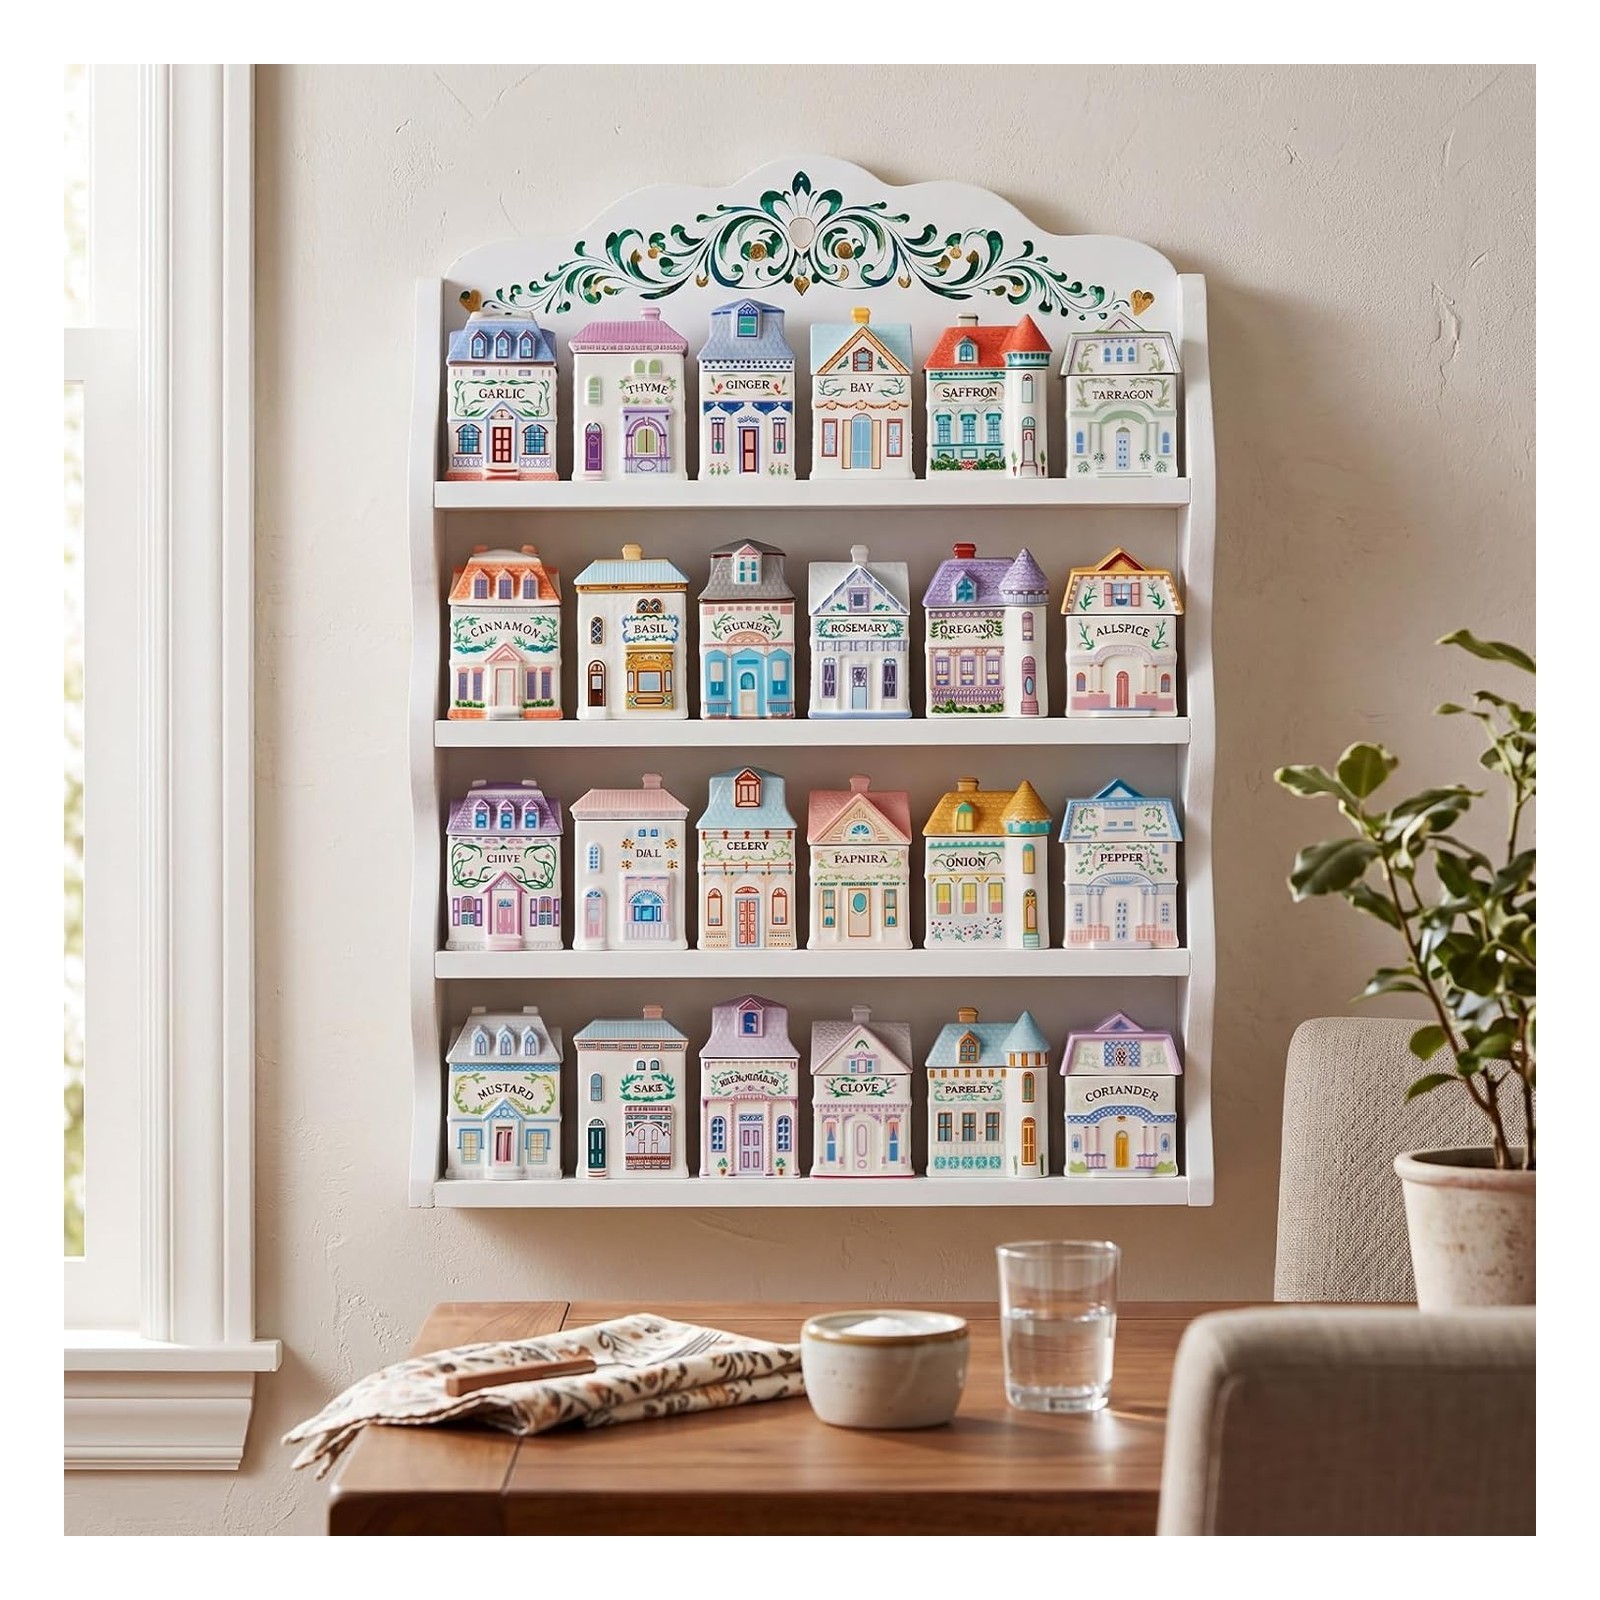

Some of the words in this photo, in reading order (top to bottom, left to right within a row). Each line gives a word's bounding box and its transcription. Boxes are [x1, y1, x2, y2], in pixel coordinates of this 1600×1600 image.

[626, 383, 670, 395] THYME
[726, 379, 770, 390] GINGER
[850, 383, 874, 392] BAY
[478, 389, 525, 399] GARLIC
[942, 386, 998, 397] SAFFRON
[1092, 389, 1154, 399] TARRAGON
[470, 620, 541, 638] CINNAMON
[634, 624, 668, 634] BASIL
[831, 623, 889, 633] ROSEMARY
[939, 623, 994, 634] OREGANO
[1095, 623, 1151, 638] ALLSPICE
[726, 841, 769, 851] CELERY
[834, 854, 888, 864] PAPNIRA
[945, 857, 986, 867] ONION
[1100, 853, 1144, 863] PEPPER
[477, 1083, 535, 1101] MUSTARD
[840, 1083, 879, 1093] CLOVE
[1085, 1085, 1159, 1103] CORIANDER
